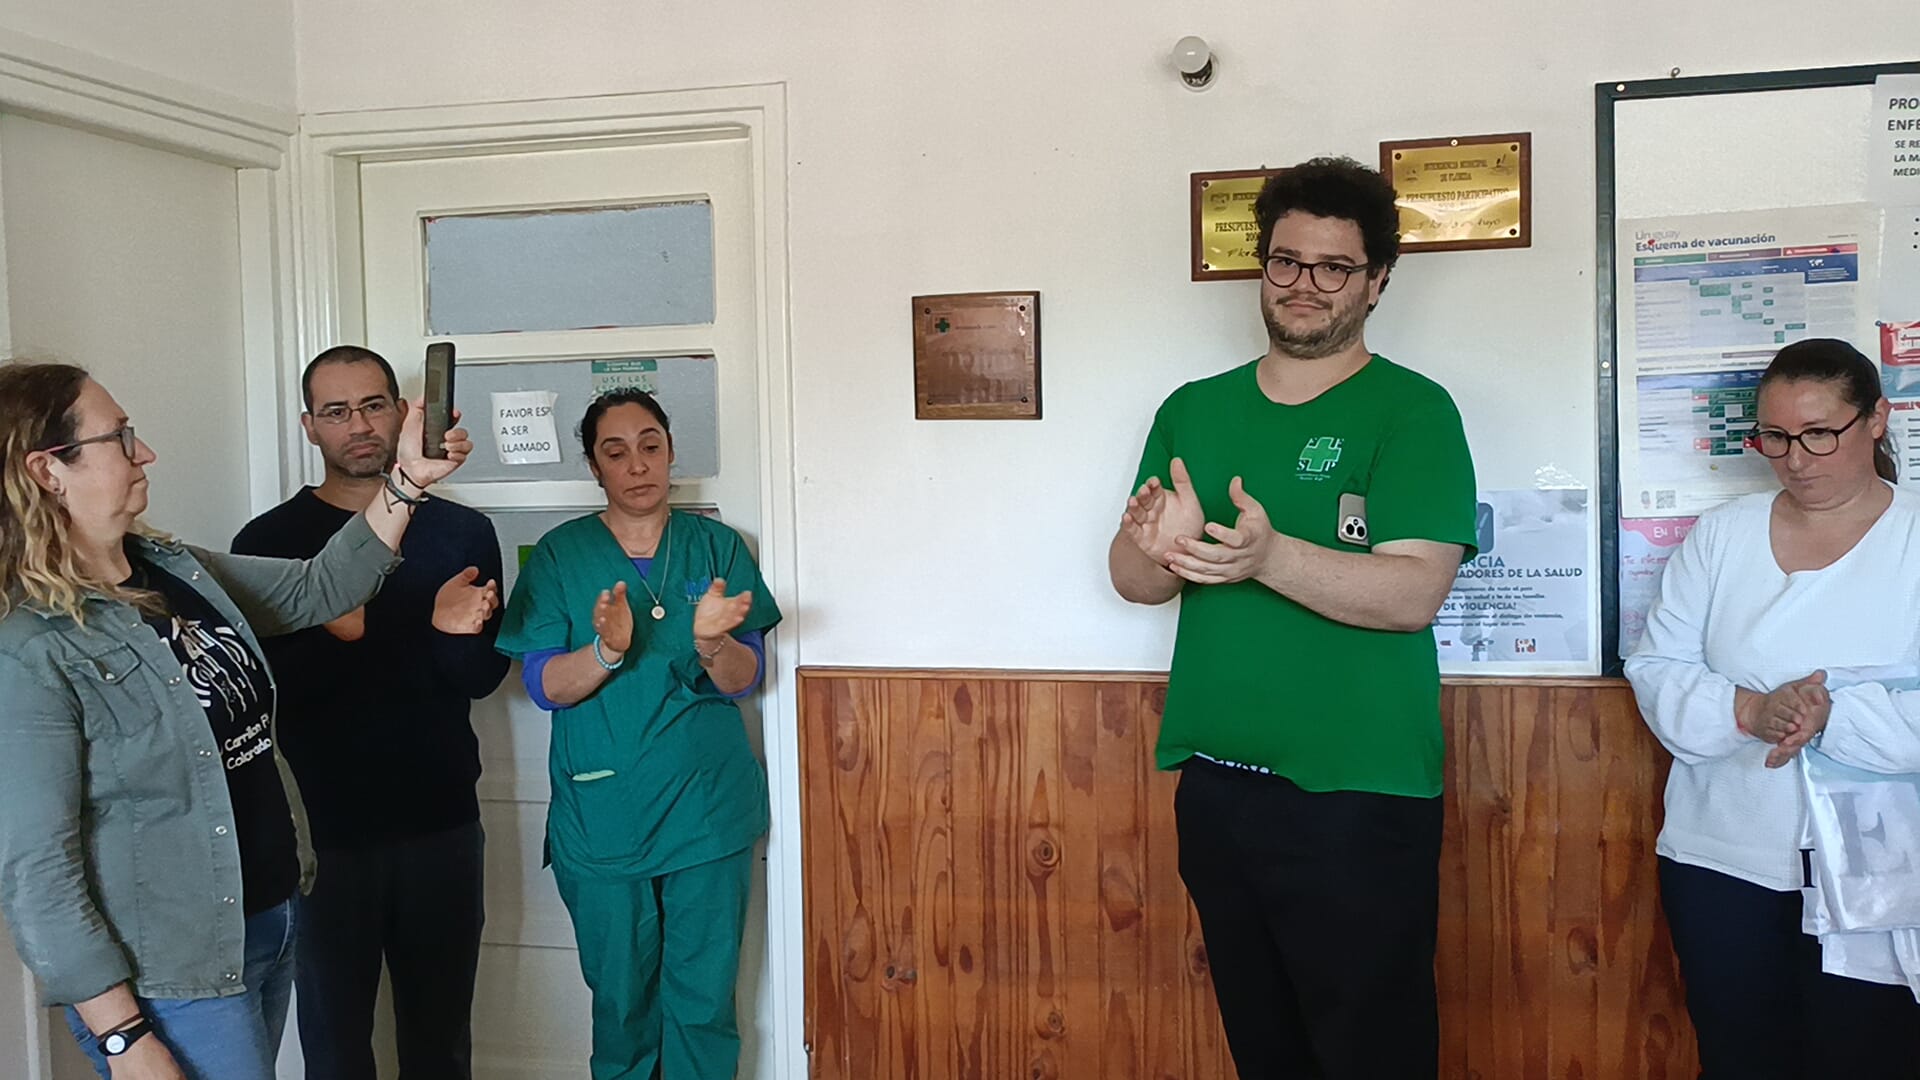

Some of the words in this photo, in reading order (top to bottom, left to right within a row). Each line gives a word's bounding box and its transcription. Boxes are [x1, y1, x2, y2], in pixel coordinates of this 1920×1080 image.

[1889, 98, 1920, 109] PRO
[1895, 140, 1906, 148] SE
[1894, 154, 1906, 162] LA
[1635, 230, 1680, 241] Uruguay
[1635, 240, 1688, 253] Esquema
[1690, 238, 1705, 248] de
[1708, 232, 1776, 247] vacunación
[500, 408, 533, 418] FAVOR
[501, 426, 508, 435] A
[511, 425, 528, 435] SER
[502, 441, 550, 453] LLAMADO
[1508, 569, 1524, 577] DE
[1527, 569, 1541, 577] LA
[1545, 568, 1583, 577] SALUD
[1443, 603, 1456, 611] DE
[1460, 601, 1517, 611] VIOLENCIA!
[227, 738, 272, 769] Colorado
